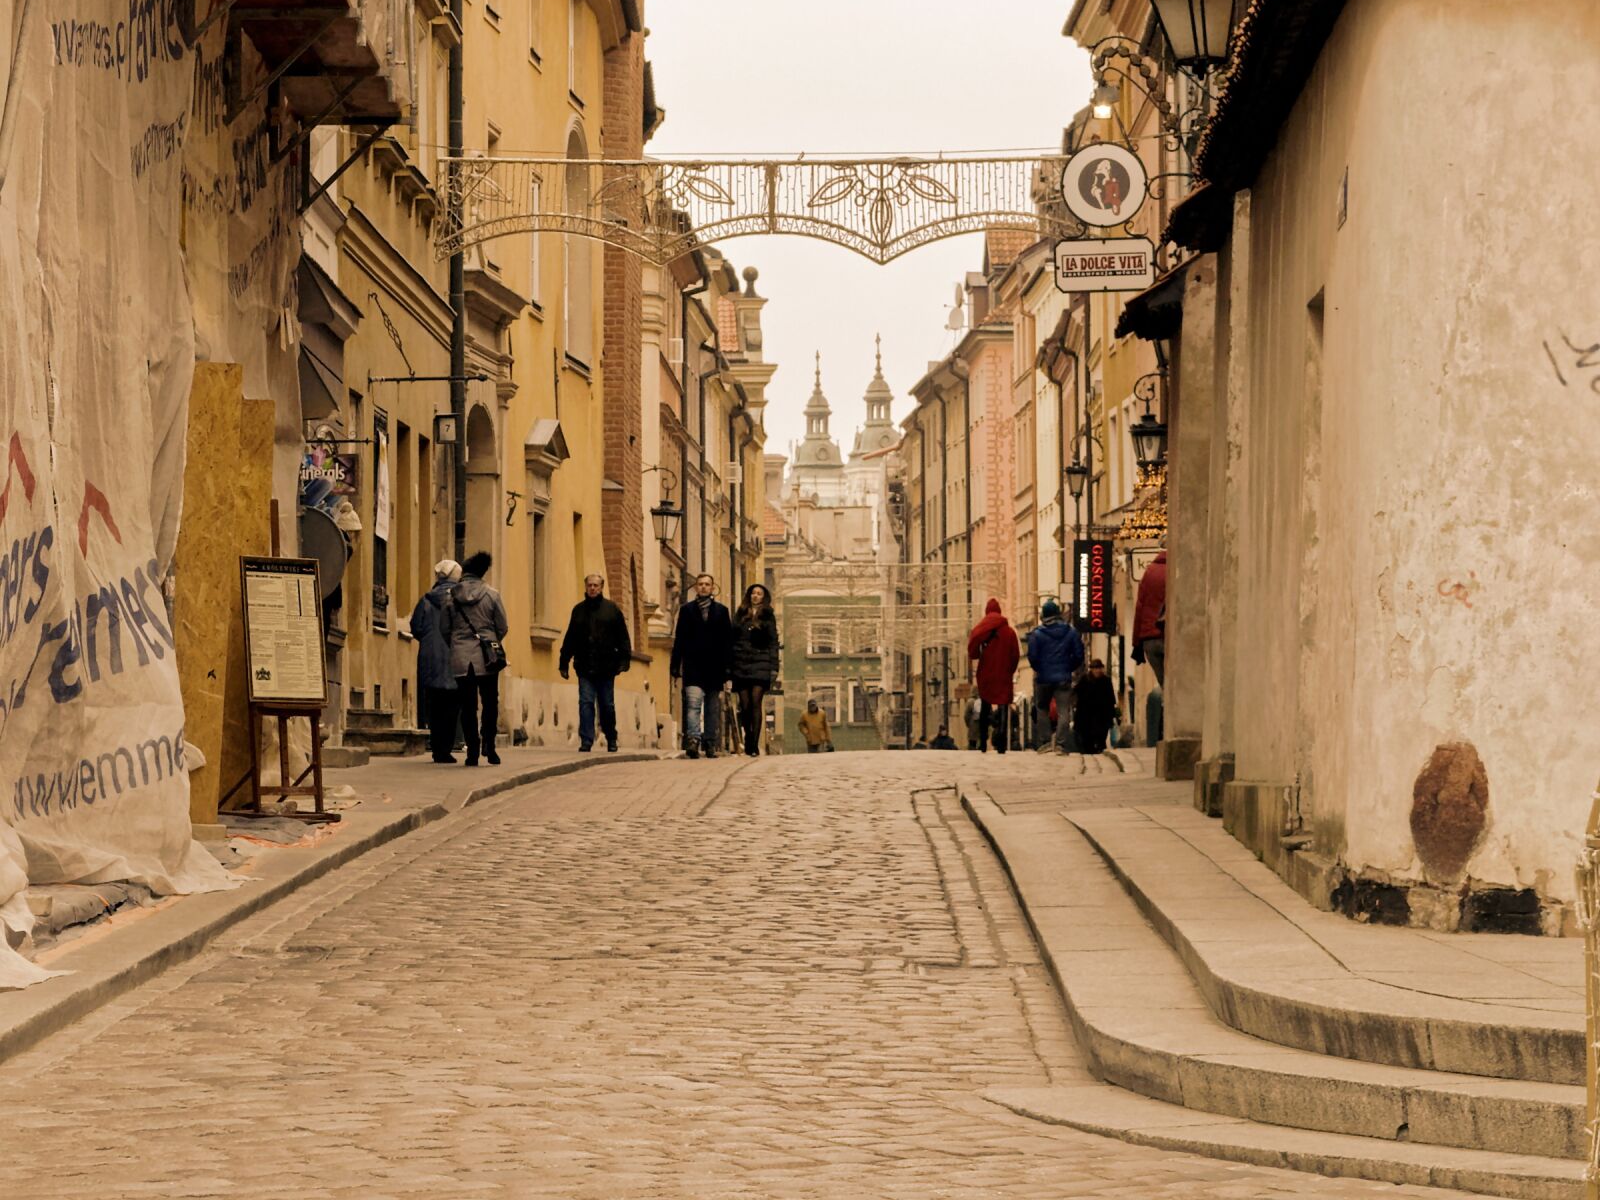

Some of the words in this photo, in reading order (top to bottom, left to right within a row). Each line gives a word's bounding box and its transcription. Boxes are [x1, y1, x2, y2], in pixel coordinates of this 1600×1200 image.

[1066, 257, 1077, 271] LA
[1080, 256, 1115, 271] DOLCE
[1119, 255, 1143, 269] VITA
[300, 462, 346, 481] inerals
[1091, 544, 1105, 628] GOŚCINIEC
